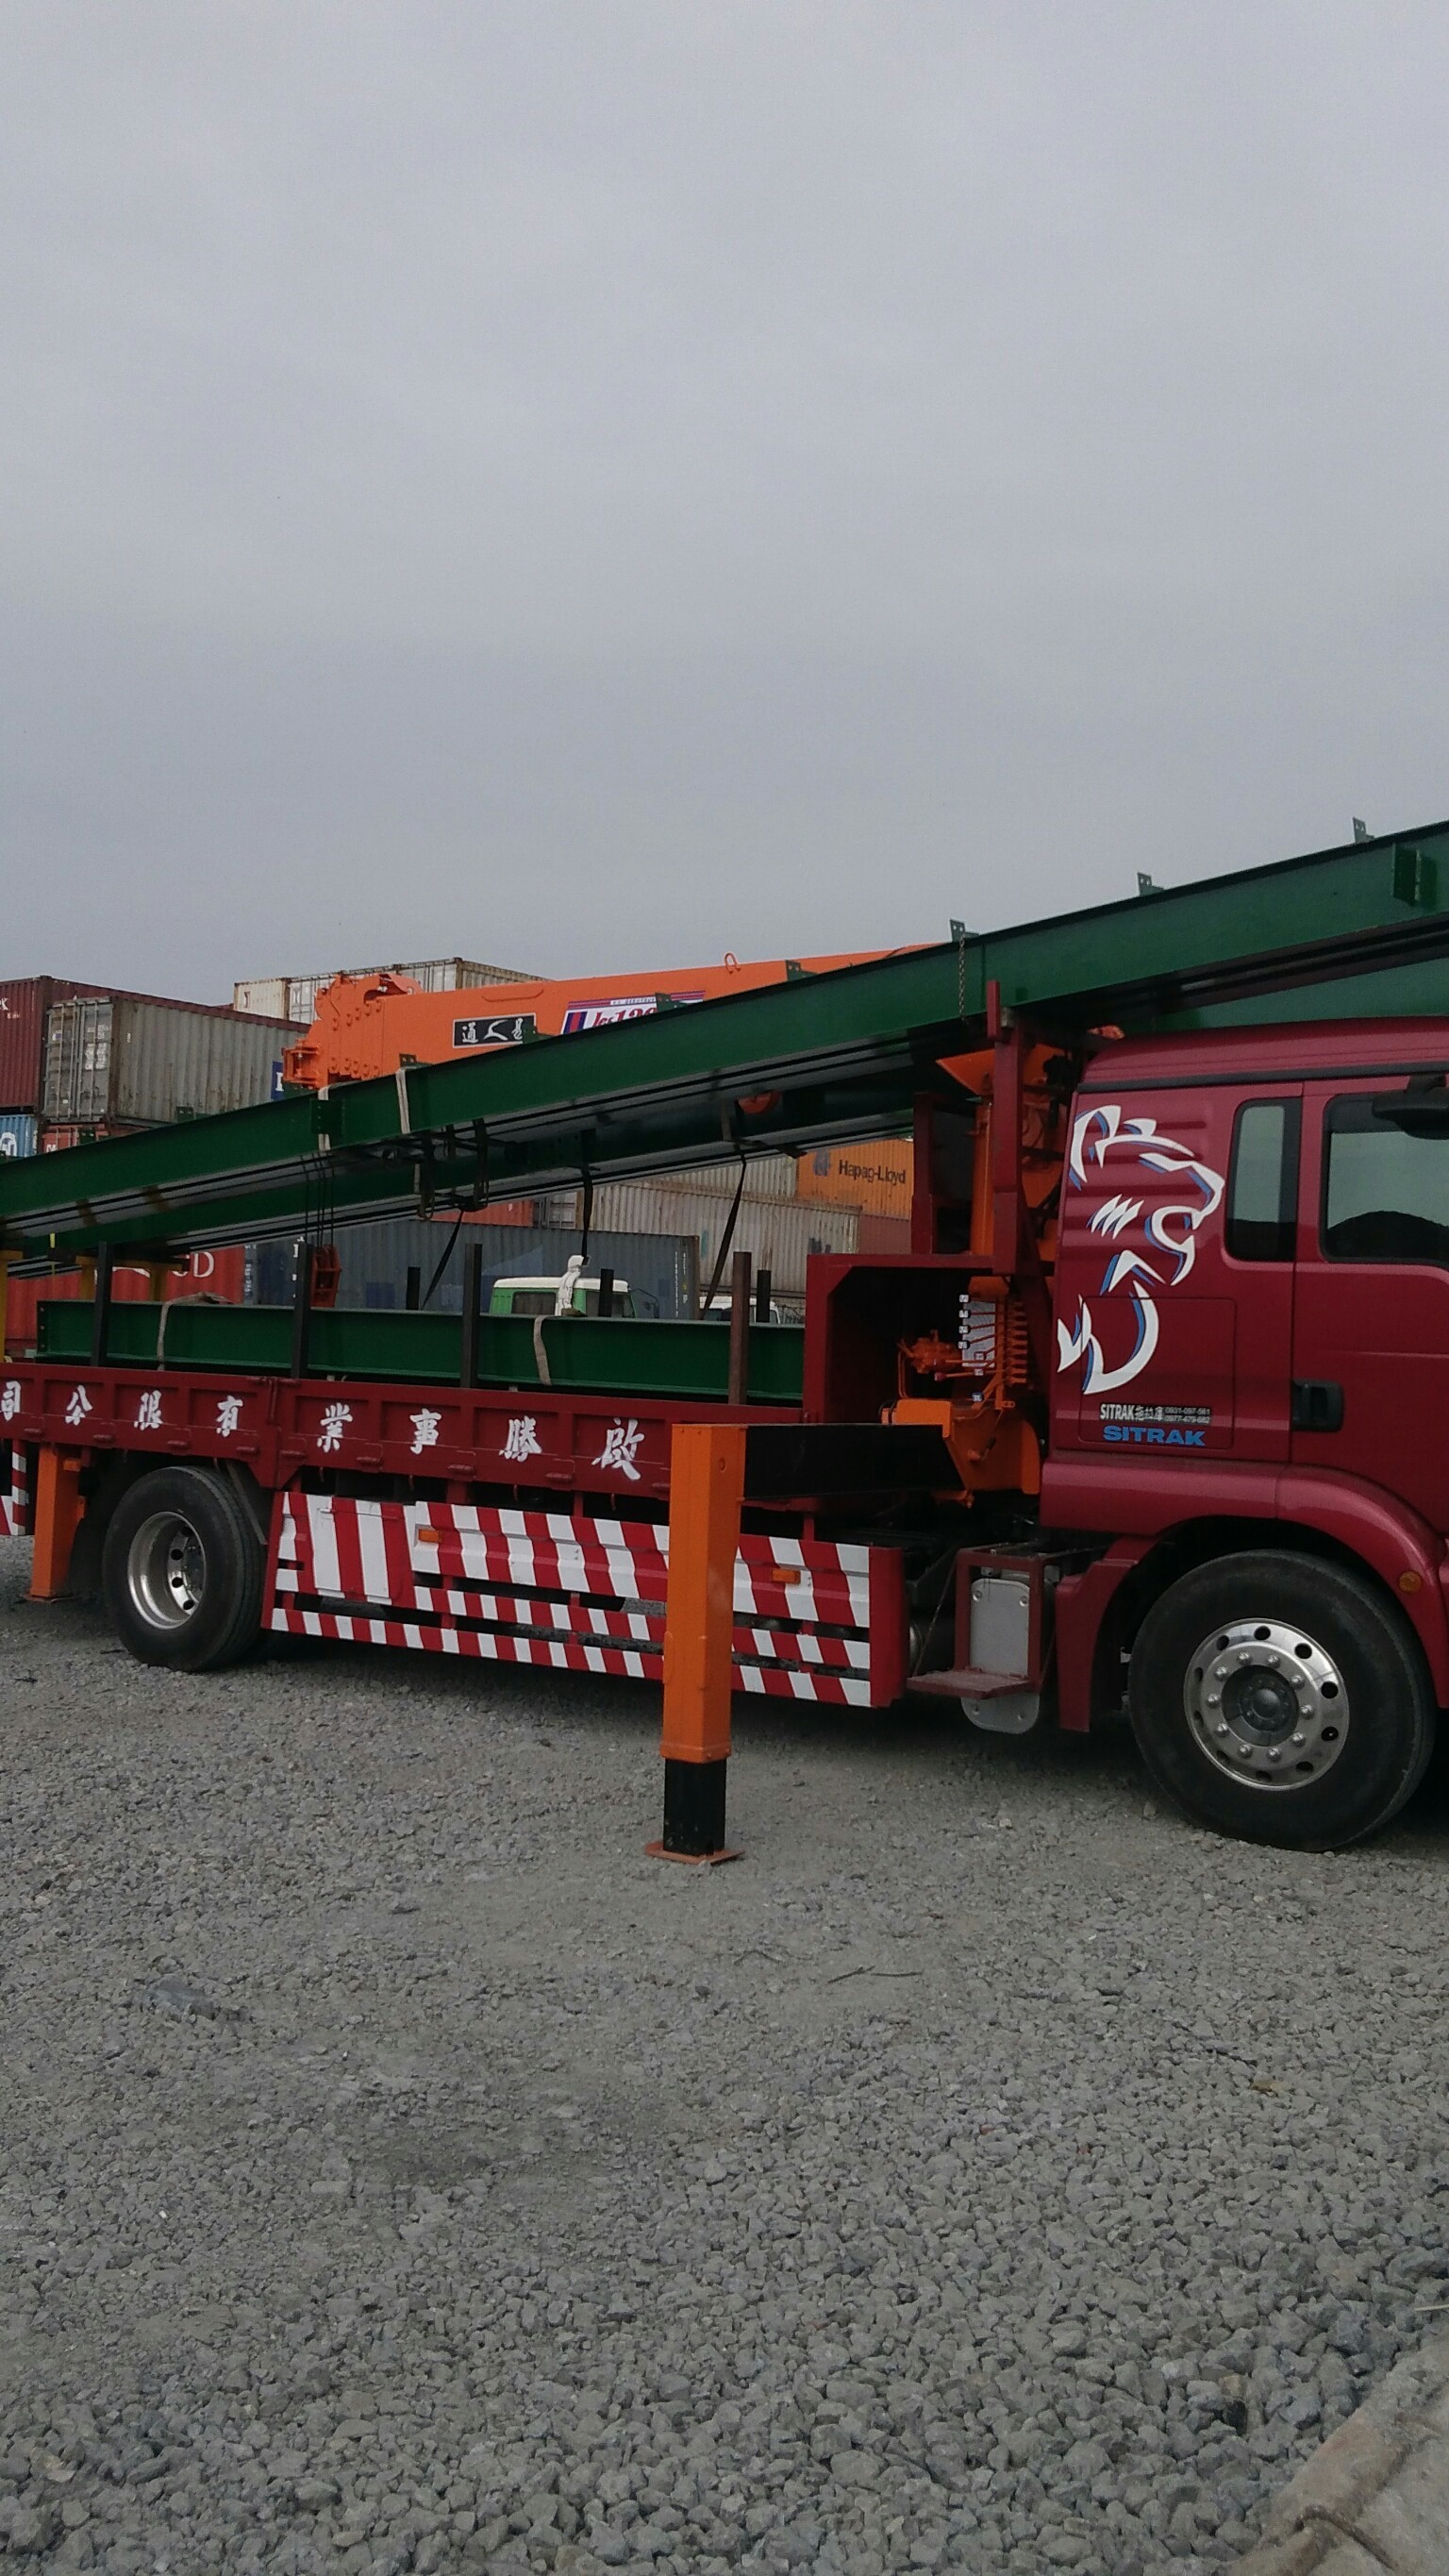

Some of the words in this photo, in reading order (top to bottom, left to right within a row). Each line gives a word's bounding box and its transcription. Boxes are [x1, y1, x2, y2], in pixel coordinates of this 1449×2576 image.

[839, 1160, 906, 1185] Hapag-Lloyd
[1100, 1404, 1135, 1420] SITRAK
[1103, 1425, 1206, 1447] SITRAK
